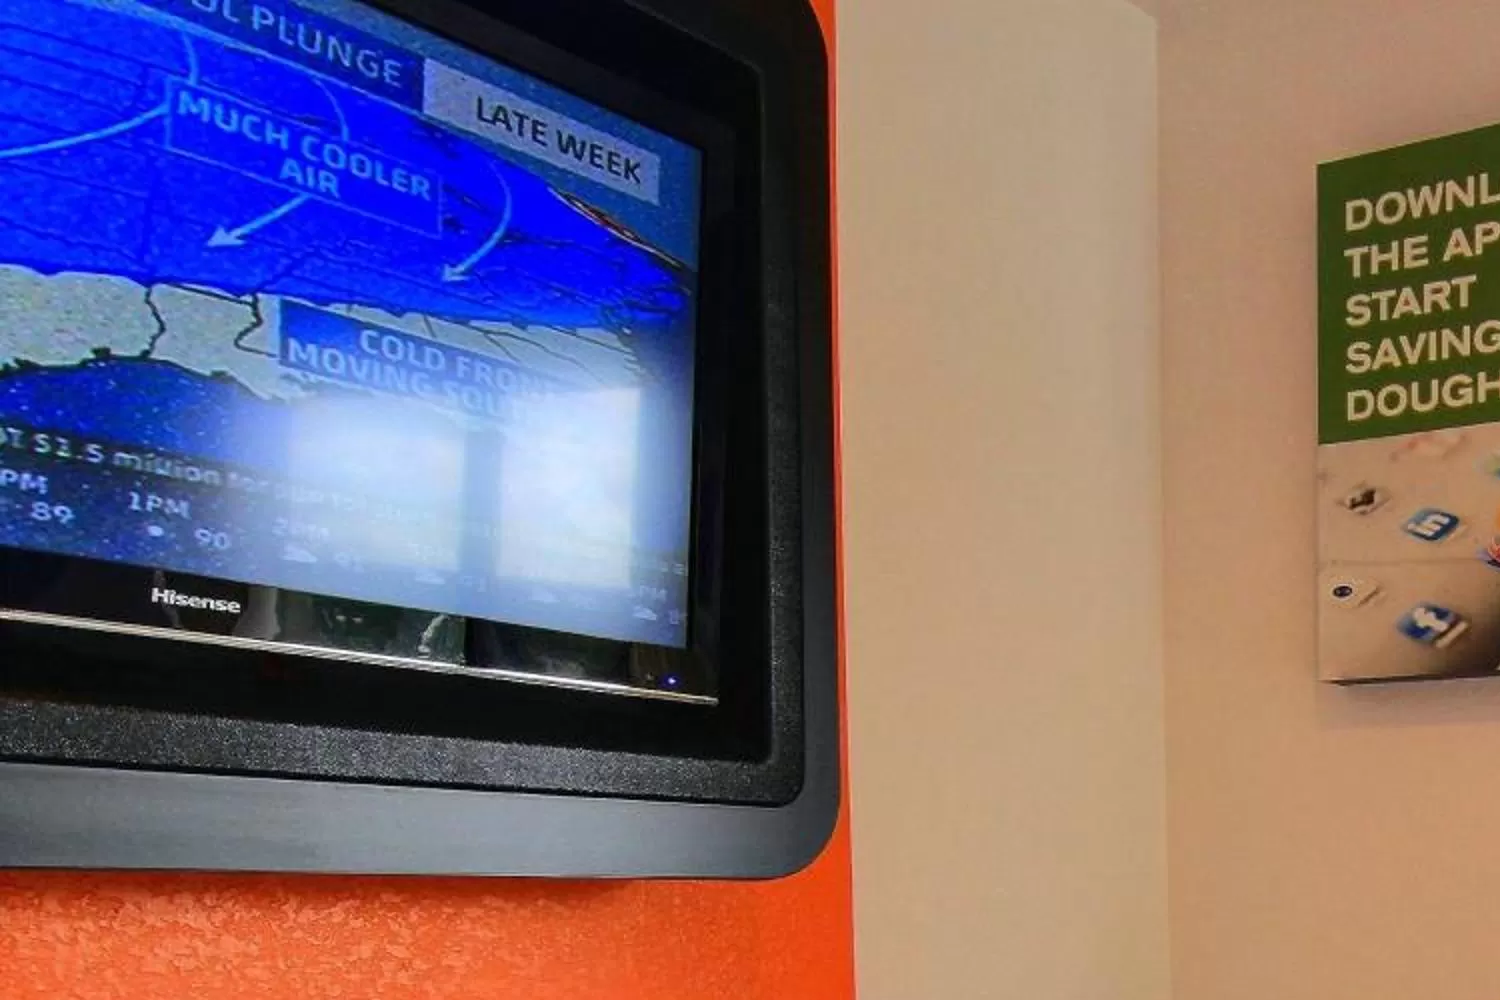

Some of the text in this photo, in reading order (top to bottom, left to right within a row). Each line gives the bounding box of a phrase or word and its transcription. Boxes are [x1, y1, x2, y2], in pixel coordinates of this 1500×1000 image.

[251, 4, 401, 87] PLUNGE
[178, 91, 430, 200] MUCH COOLER
[476, 97, 641, 184] LATE WEEK
[279, 159, 340, 199] AIR
[1344, 235, 1429, 278] THE
[1345, 274, 1477, 327] START
[288, 337, 431, 395] MOVING
[359, 329, 446, 370] COLD
[113, 451, 222, 486] million
[31, 501, 231, 550] 89 90
[128, 491, 192, 520] 1PM
[151, 587, 241, 613] Hisense
